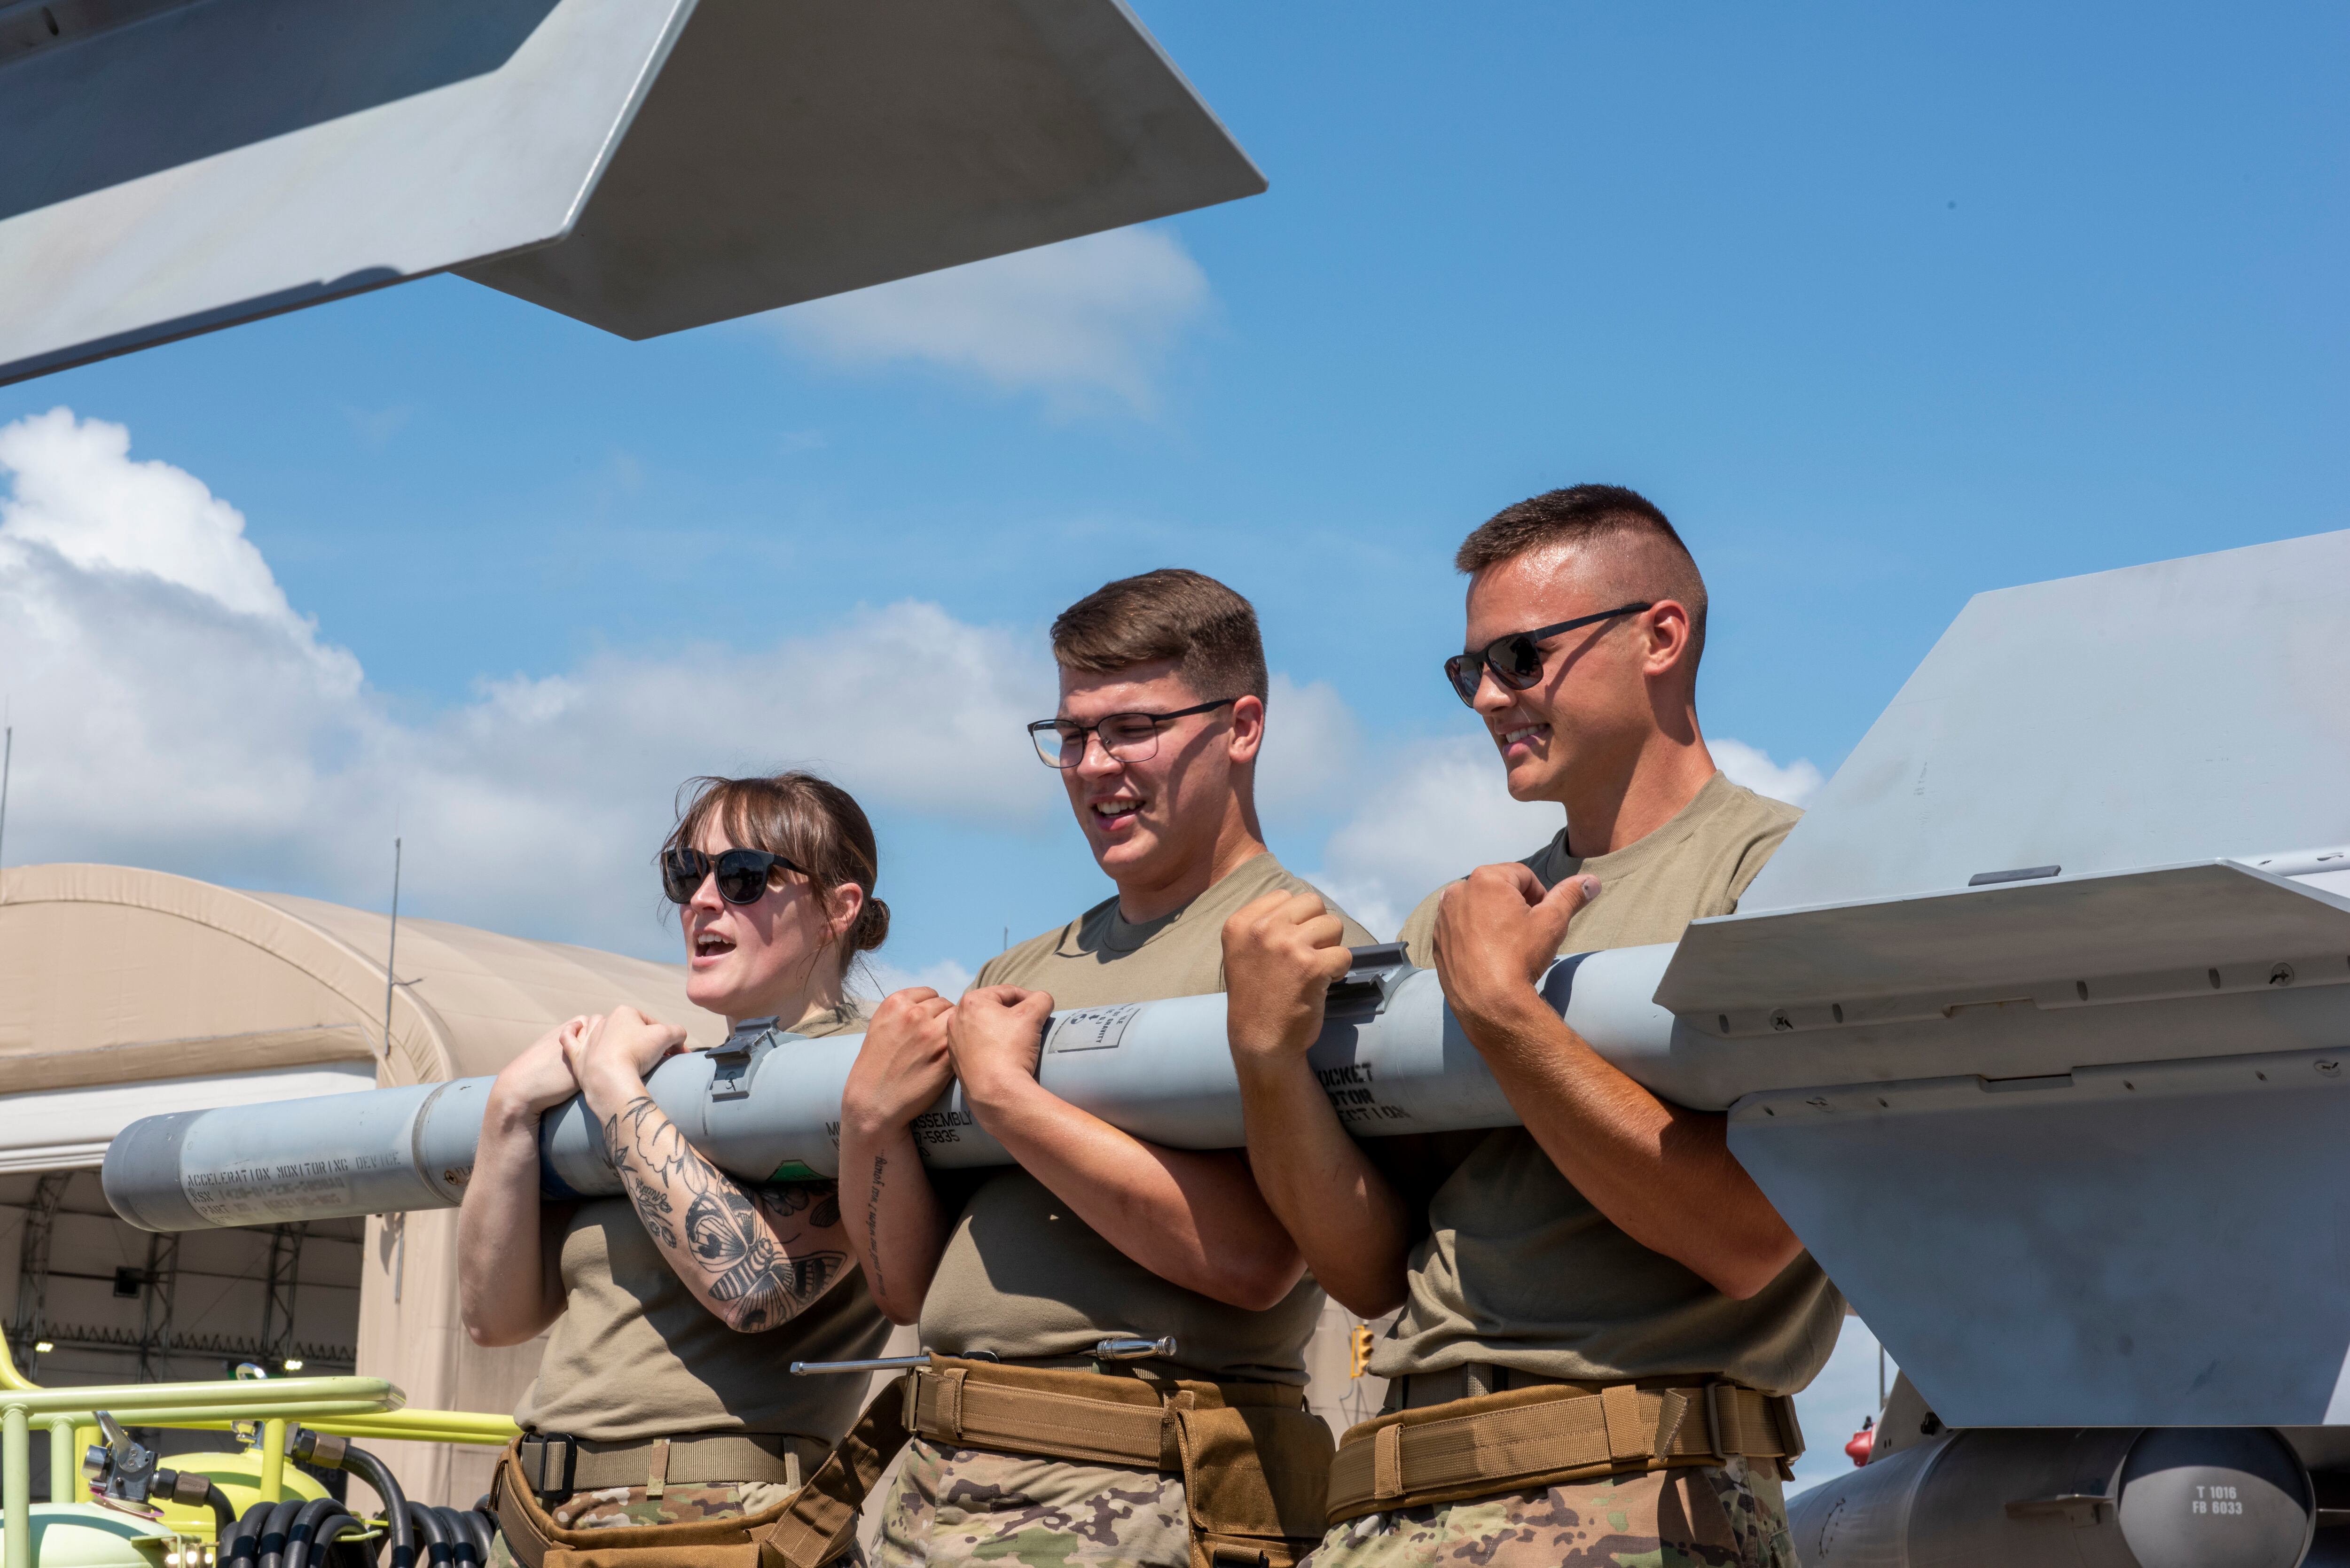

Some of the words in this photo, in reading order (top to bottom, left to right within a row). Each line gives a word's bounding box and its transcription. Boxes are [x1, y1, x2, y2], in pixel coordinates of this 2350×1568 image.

[1096, 1019, 1113, 1043] GRAVITY
[1318, 1062, 1373, 1087] OCKET
[913, 1110, 972, 1129] ASSEMBLY
[1339, 1105, 1411, 1122] ECTION
[913, 1129, 960, 1146] 7-5835
[188, 1167, 271, 1187] ACCELERATION
[276, 1158, 348, 1179] MONITORING
[355, 1152, 401, 1170] DEVICE
[873, 1149, 887, 1187] young...
[190, 1190, 214, 1203] NSN
[871, 1186, 880, 1203] was
[199, 1204, 230, 1215] PART
[868, 1203, 877, 1211] I
[866, 1211, 877, 1236] when
[870, 1237, 877, 1253] me
[2196, 1486, 2205, 1499] T
[2210, 1486, 2237, 1499] 1016
[2193, 1501, 2207, 1513] FB
[2212, 1501, 2242, 1514] 6033
